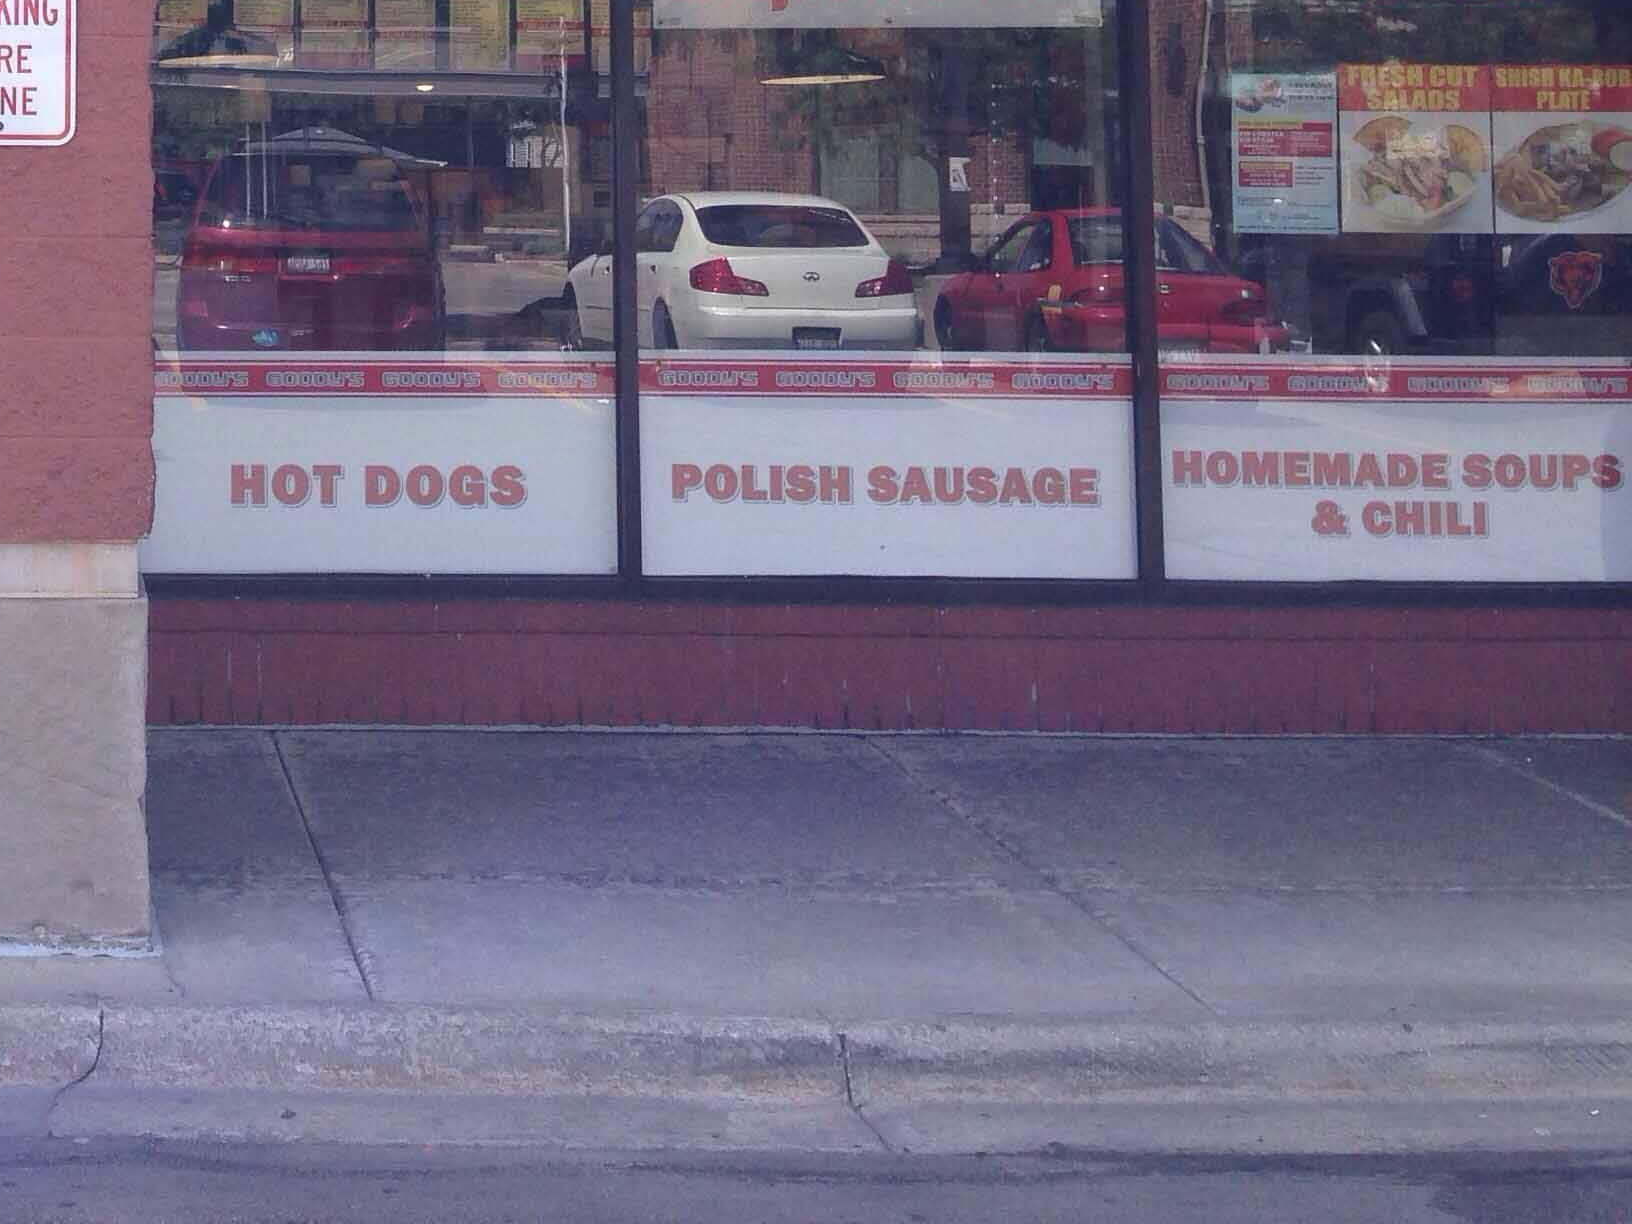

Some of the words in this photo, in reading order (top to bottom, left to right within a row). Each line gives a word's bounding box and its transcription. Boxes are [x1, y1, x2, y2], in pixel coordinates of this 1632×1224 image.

[1344, 65, 1424, 88] FRESH
[1429, 65, 1479, 88] CUT
[1364, 88, 1461, 110] SALADS
[1535, 89, 1591, 110] PLATE
[230, 464, 344, 509] HOT
[364, 464, 527, 509] DOGS
[671, 463, 854, 504] POLISH
[867, 465, 1101, 505] SAUSAGE
[1172, 450, 1451, 490] HOMEMADE
[1462, 454, 1624, 492] SOUPS
[1311, 500, 1350, 537] &
[1361, 501, 1489, 538] CHILI
